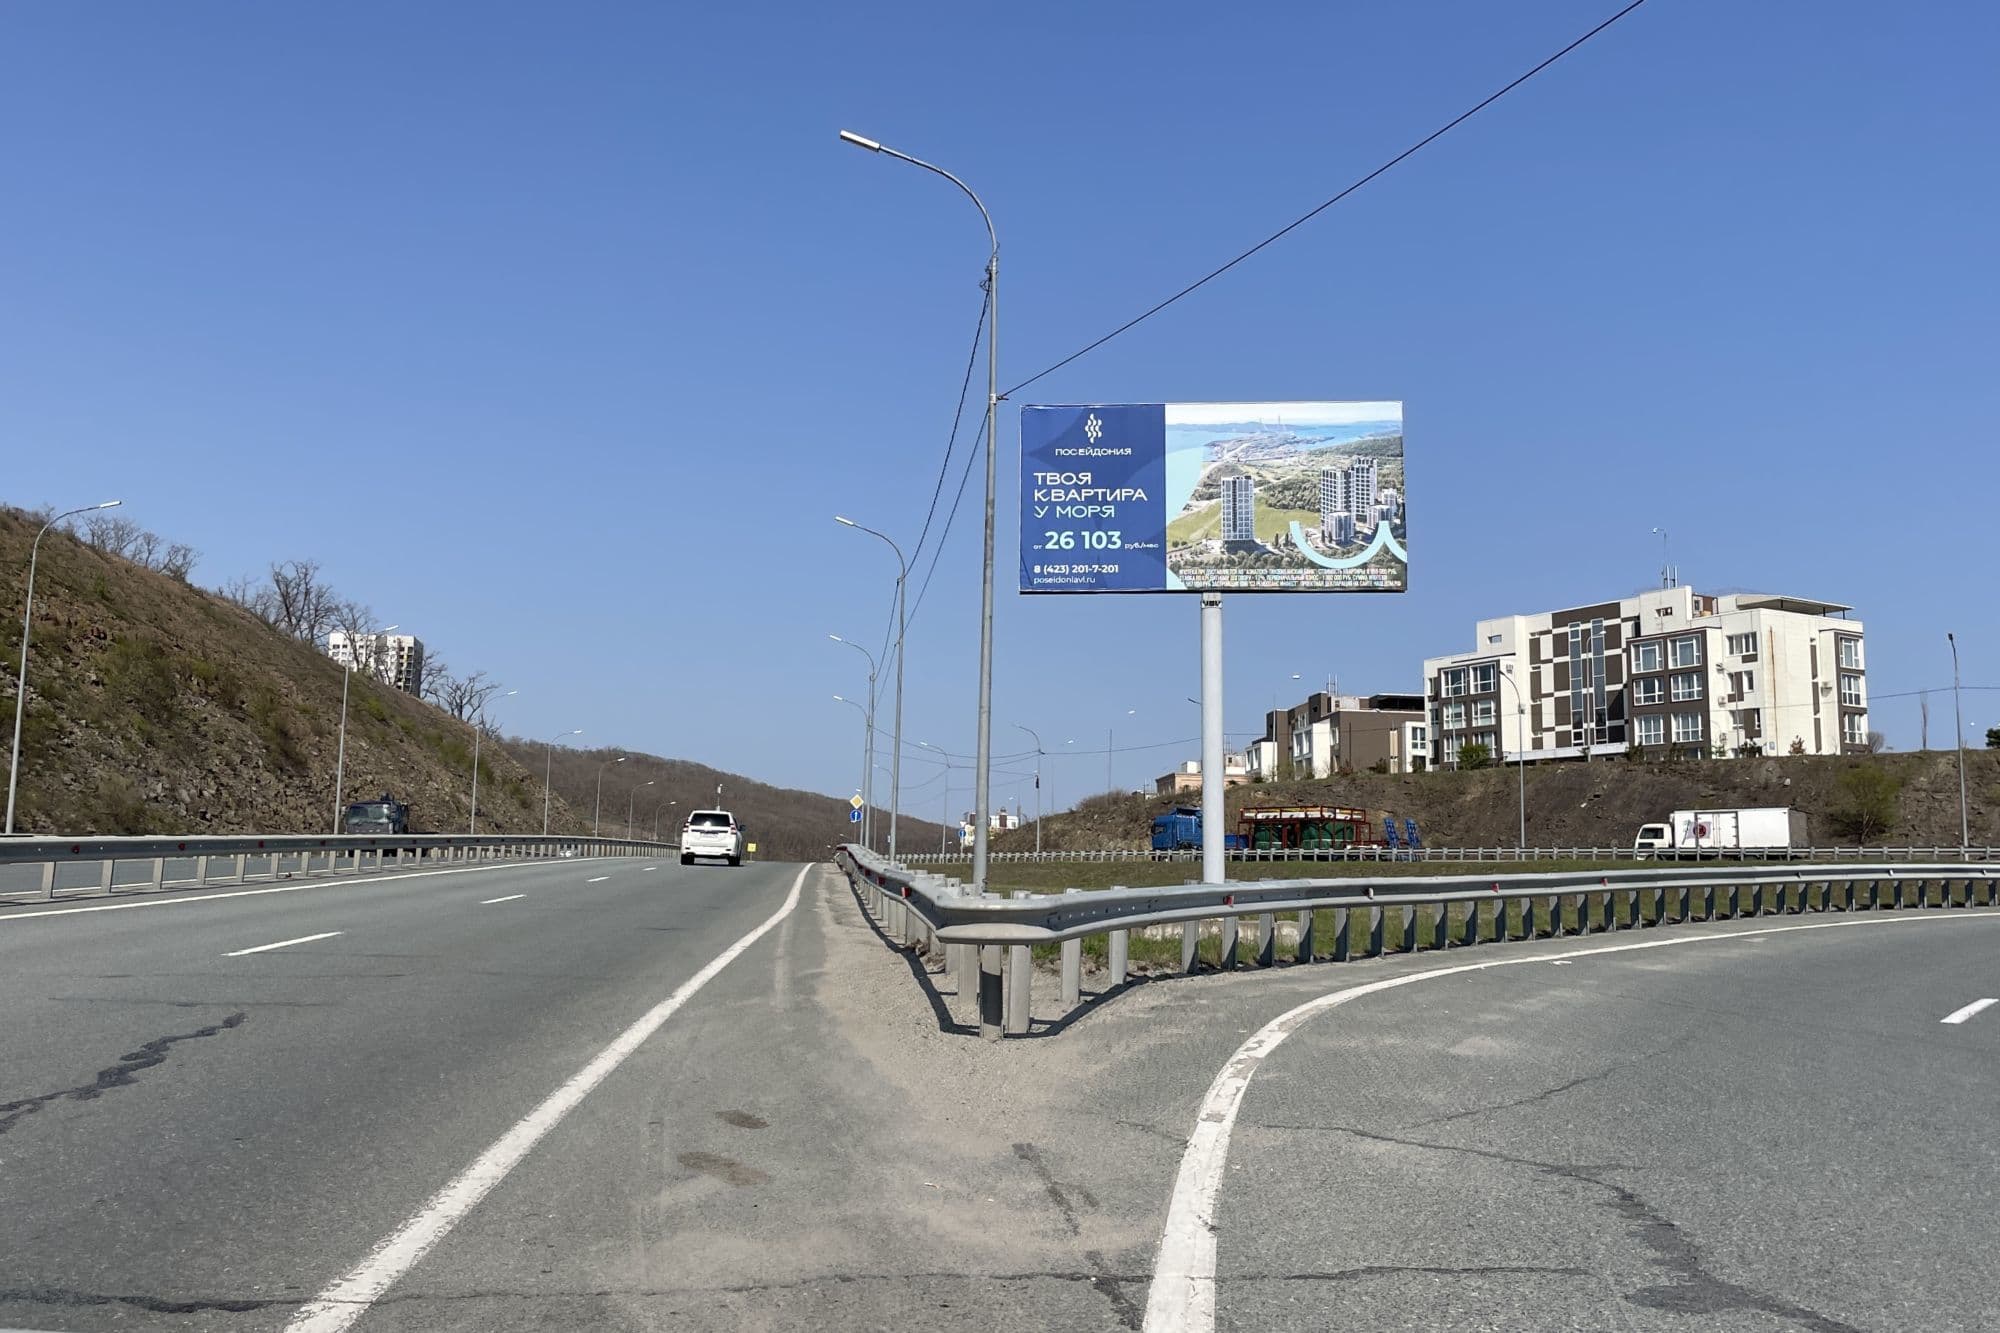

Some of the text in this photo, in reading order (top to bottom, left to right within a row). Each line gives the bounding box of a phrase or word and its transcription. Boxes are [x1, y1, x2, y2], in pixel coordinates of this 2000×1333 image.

[1055, 447, 1132, 456] ПОСЕЙДОНИЯ
[1033, 472, 1092, 485] ТВОЯ
[1033, 489, 1148, 501] КВАРТИРА
[1033, 505, 1115, 518] У МОРЯ
[1044, 531, 1075, 550] 26
[1081, 531, 1122, 550] 103
[1033, 564, 1119, 575] 8 (423) 201-7-201
